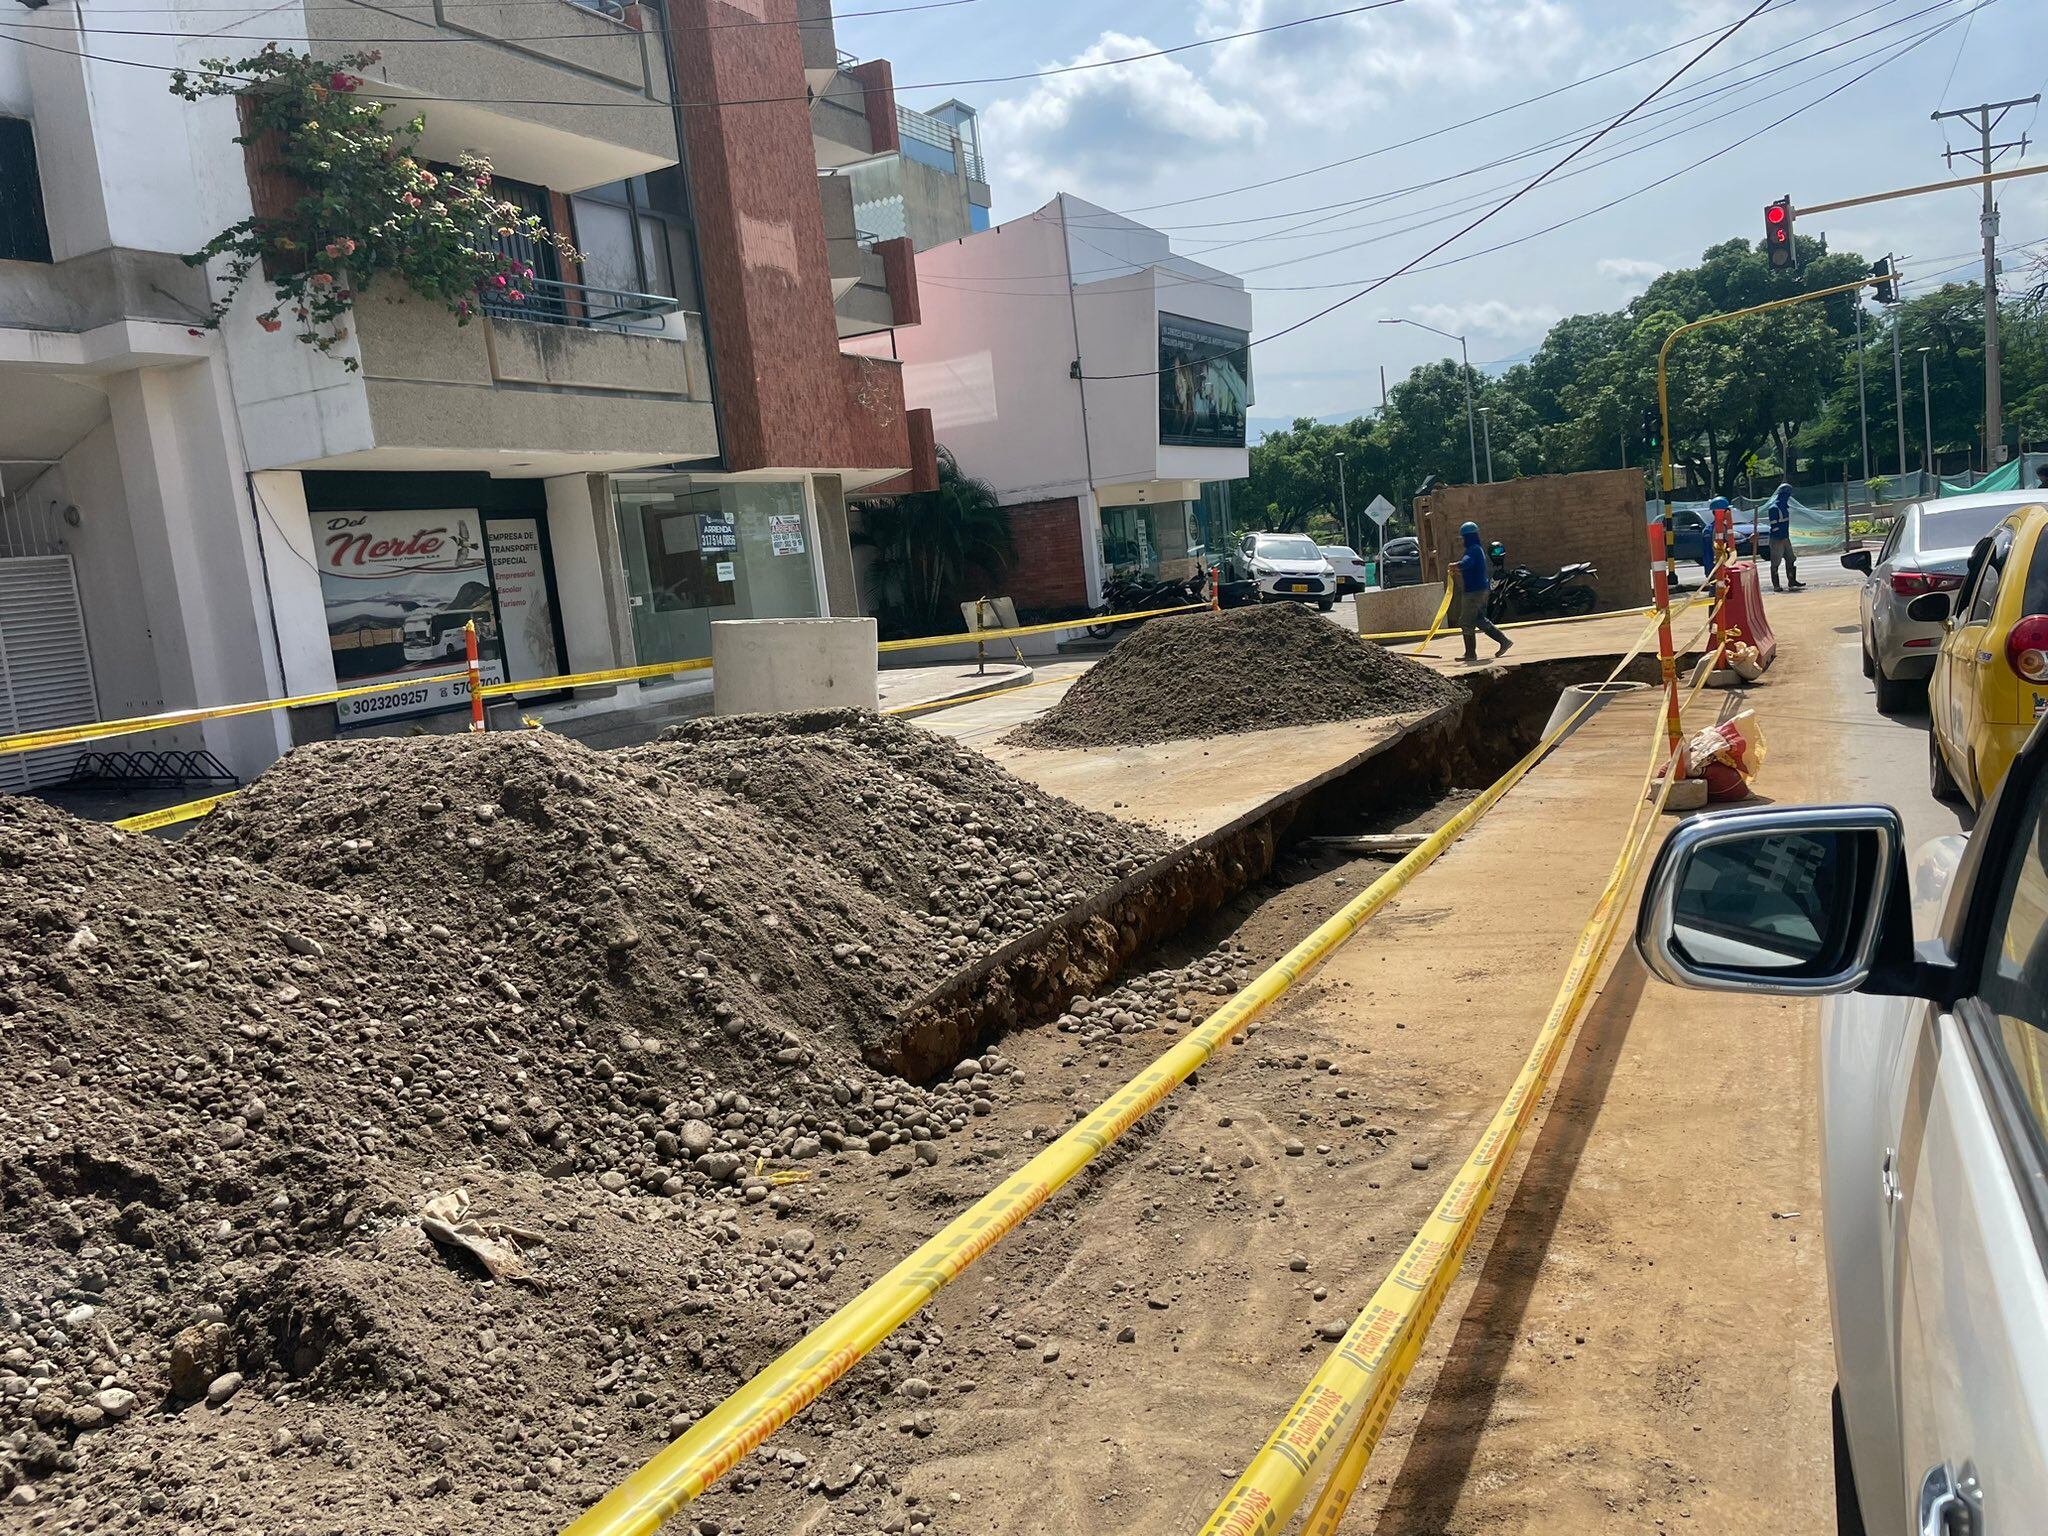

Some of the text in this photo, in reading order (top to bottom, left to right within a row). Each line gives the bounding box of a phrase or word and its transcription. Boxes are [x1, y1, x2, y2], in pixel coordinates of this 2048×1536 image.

[326, 515, 368, 531] Del
[704, 525, 733, 533] ARRIENDA
[488, 531, 534, 541] EMPRESA DE
[325, 528, 447, 566] Norte
[490, 544, 538, 554] TRANSPORTE
[493, 556, 527, 566] ESPECIAL
[495, 570, 536, 581] Empresarial
[497, 585, 522, 595] Escolar
[499, 599, 527, 608] Turismo
[353, 689, 428, 714] 3023209257
[1288, 1388, 1343, 1450] PELIGRO NO PASE
[1240, 1488, 1272, 1518] PASE
[1230, 1510, 1255, 1532] NO
